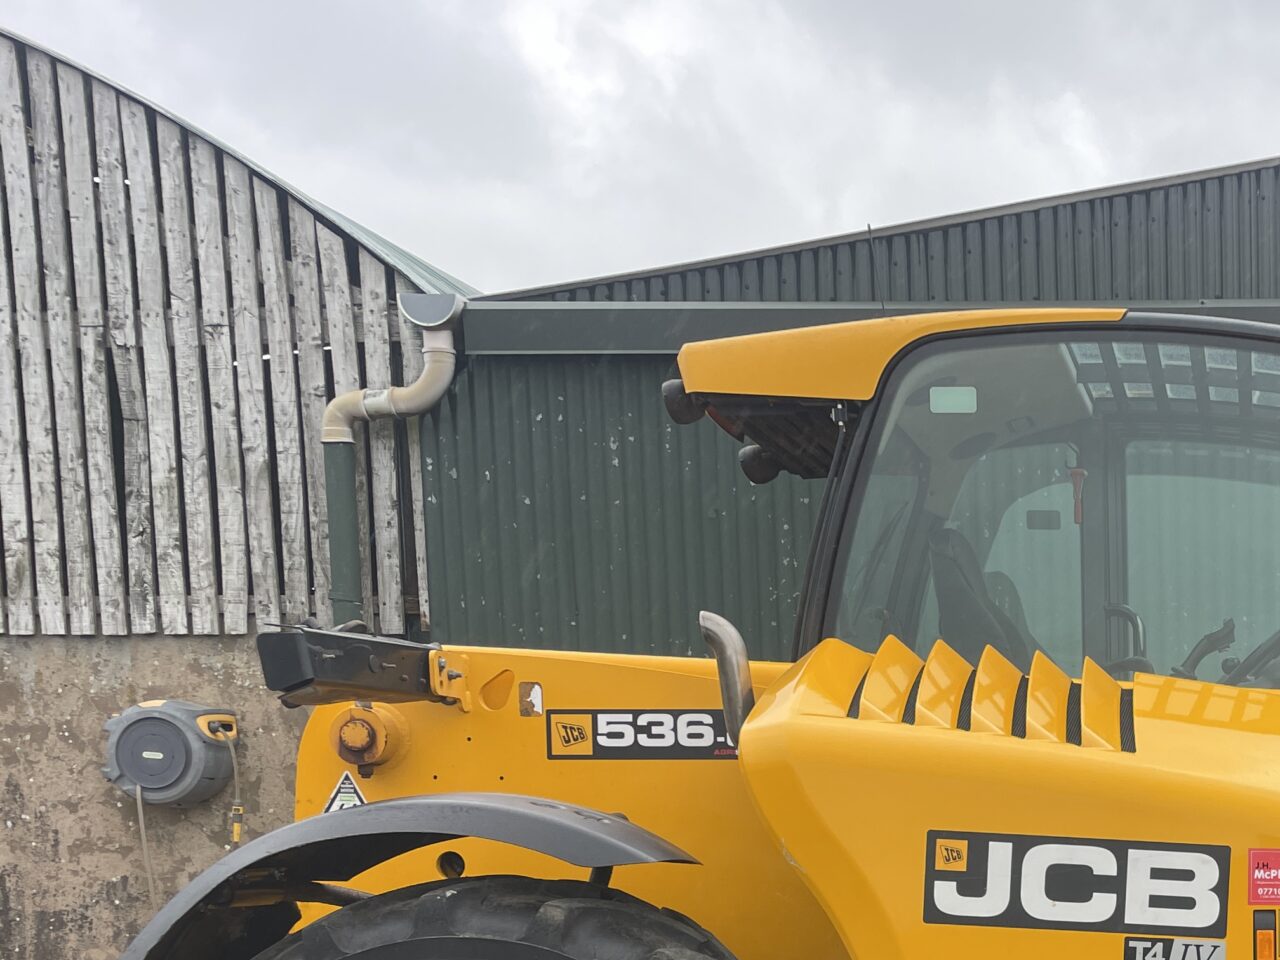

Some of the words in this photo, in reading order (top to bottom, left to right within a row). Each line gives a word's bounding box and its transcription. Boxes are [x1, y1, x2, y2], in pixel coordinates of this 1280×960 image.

[560, 723, 586, 745] JCB
[597, 713, 735, 747] 536-
[944, 847, 963, 862] JCB
[934, 841, 1220, 928] JCB
